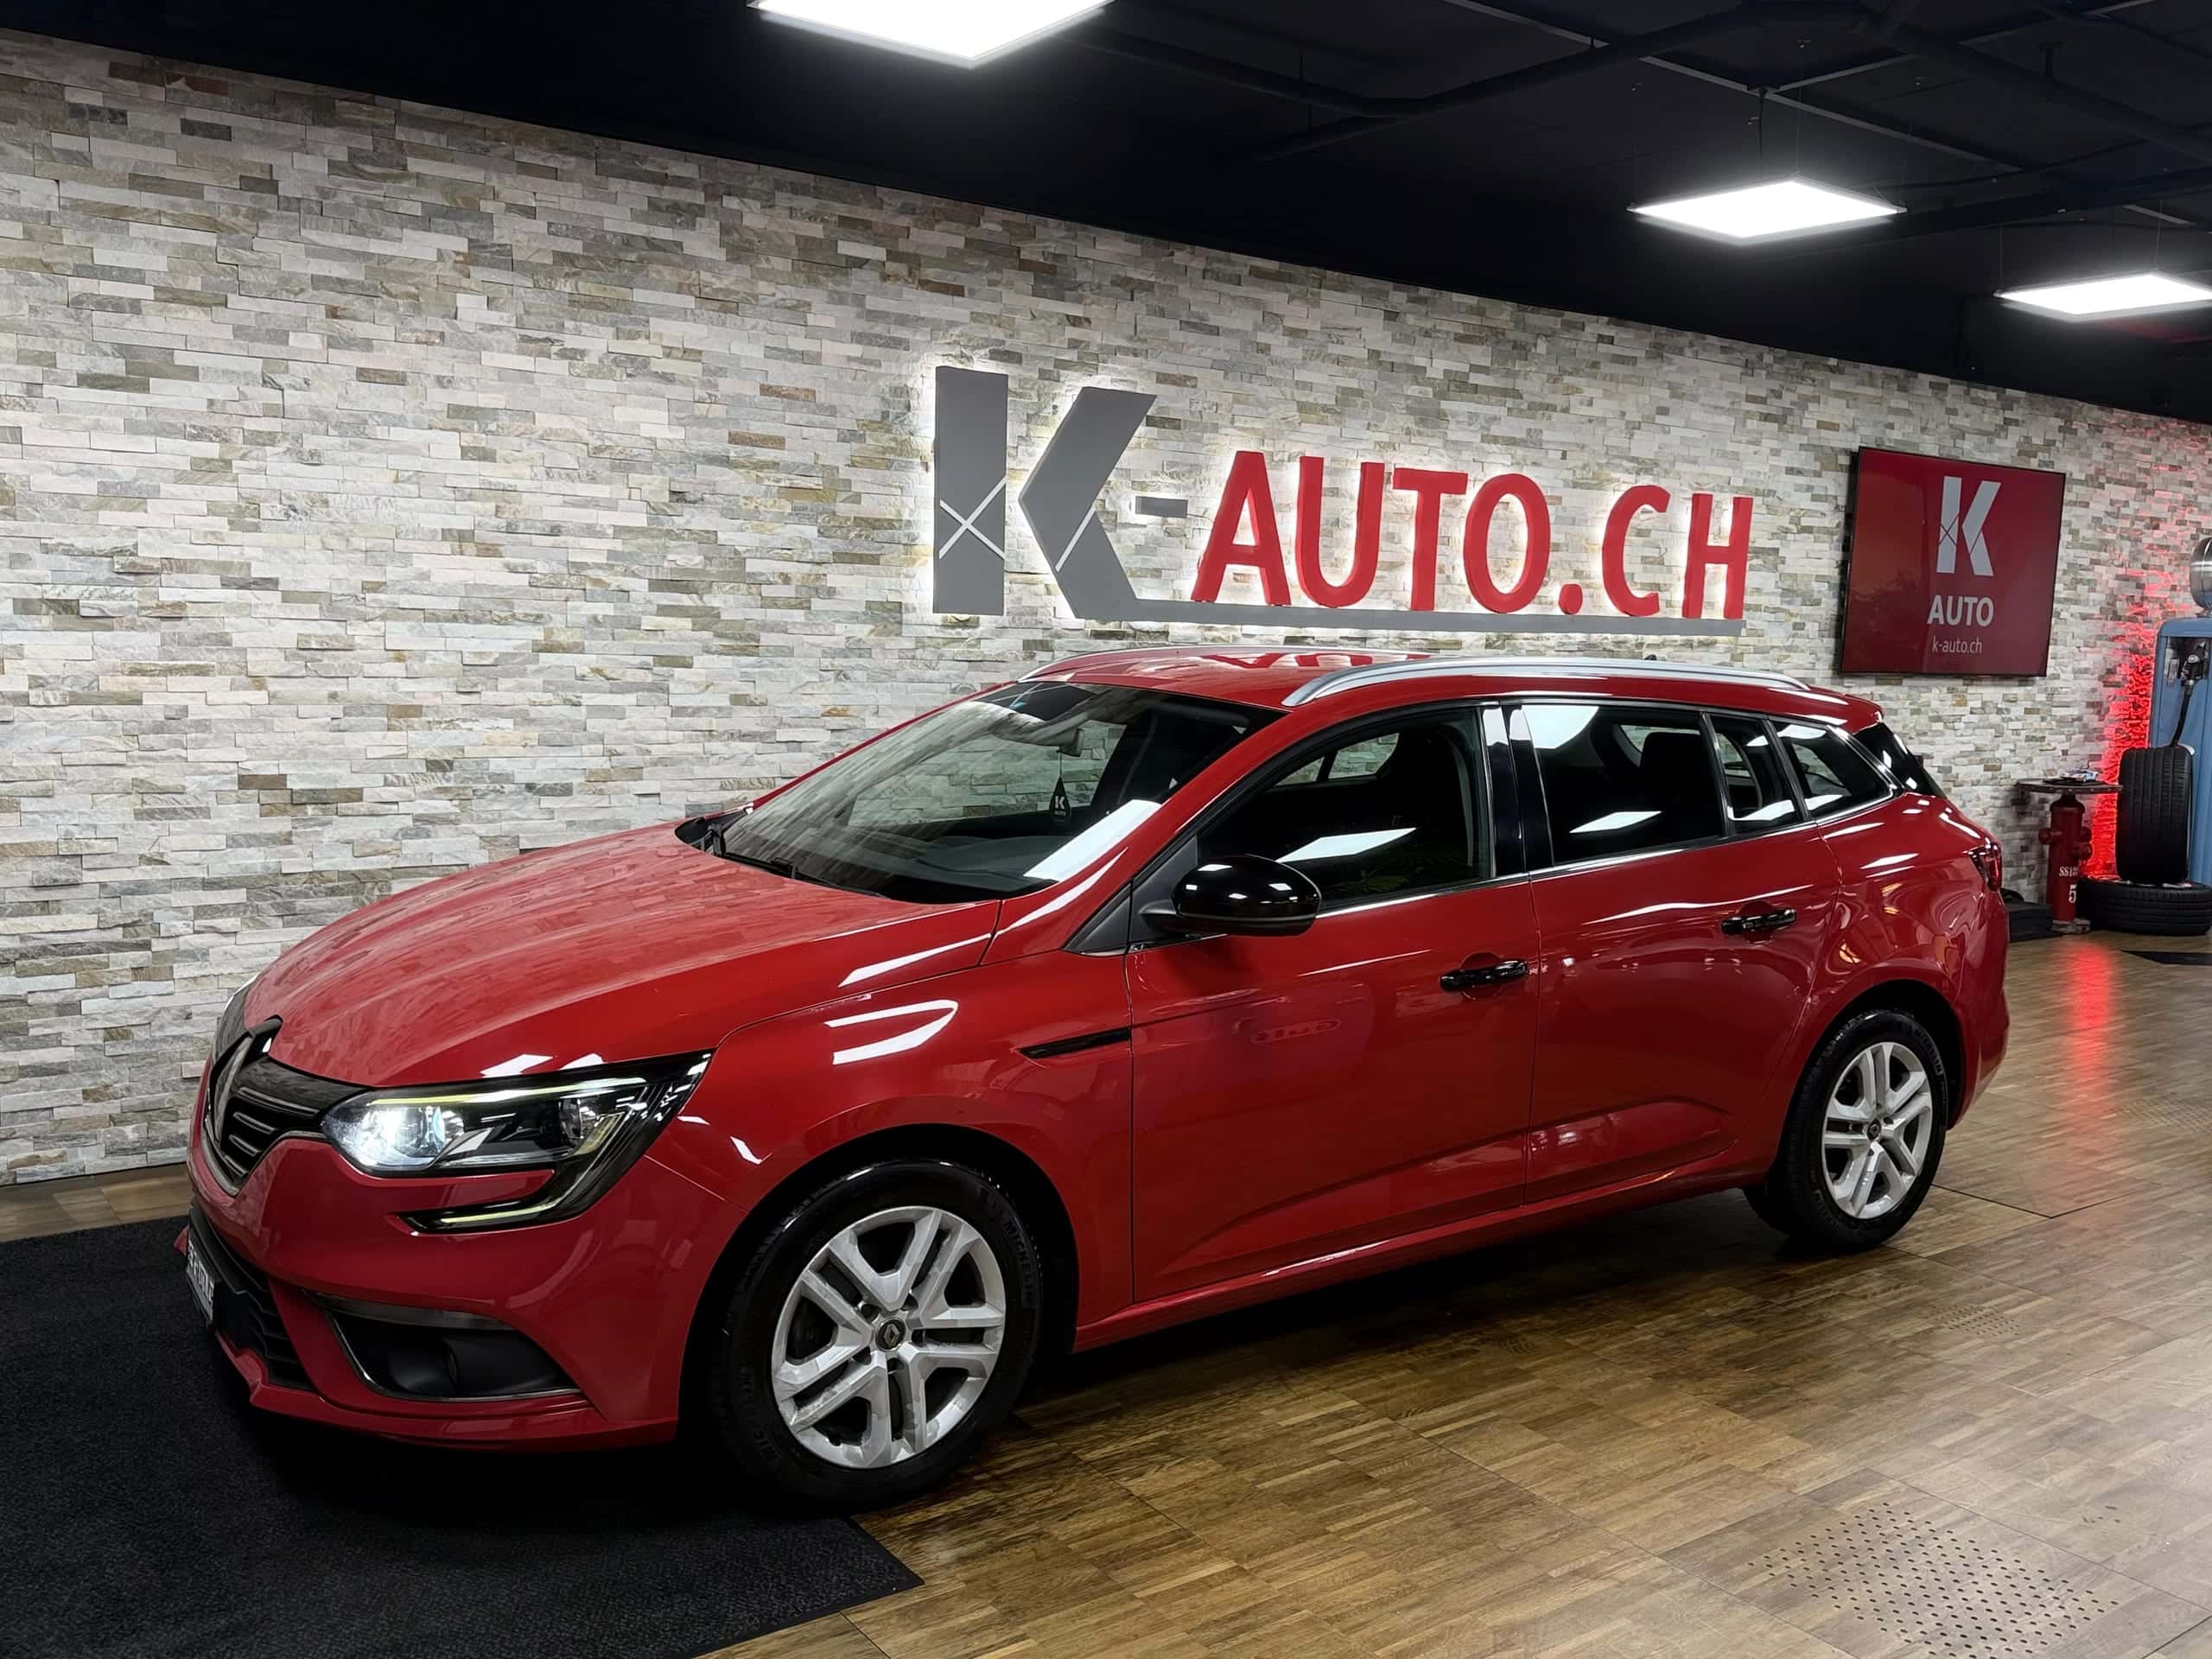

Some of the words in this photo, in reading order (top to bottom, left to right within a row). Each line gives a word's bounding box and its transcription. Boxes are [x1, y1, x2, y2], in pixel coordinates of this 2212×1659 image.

[1936, 476, 2001, 576] K
[1927, 595, 1994, 627] AUTO
[1932, 637, 1983, 654] k-auto.ch
